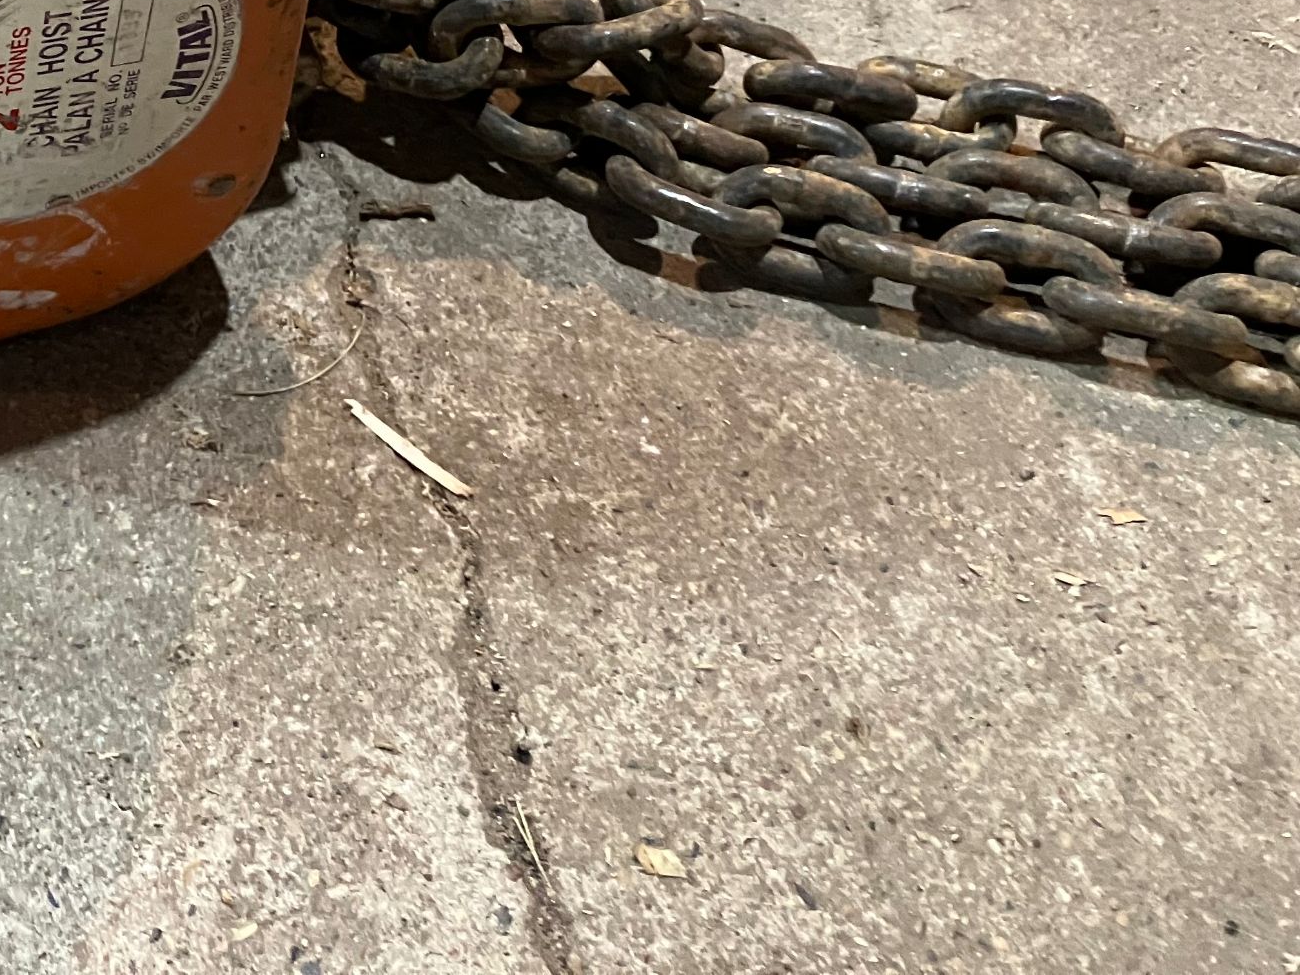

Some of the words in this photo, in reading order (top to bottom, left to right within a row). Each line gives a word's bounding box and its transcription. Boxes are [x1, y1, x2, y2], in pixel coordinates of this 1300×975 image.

[5, 26, 31, 96] TONNES
[37, 11, 72, 75] HOIST
[160, 10, 212, 100] VITAL
[211, 37, 235, 91] WESTWARD
[26, 85, 61, 147] CHAIN
[61, 91, 96, 157] PALAN
[100, 97, 118, 138] SERIAL
